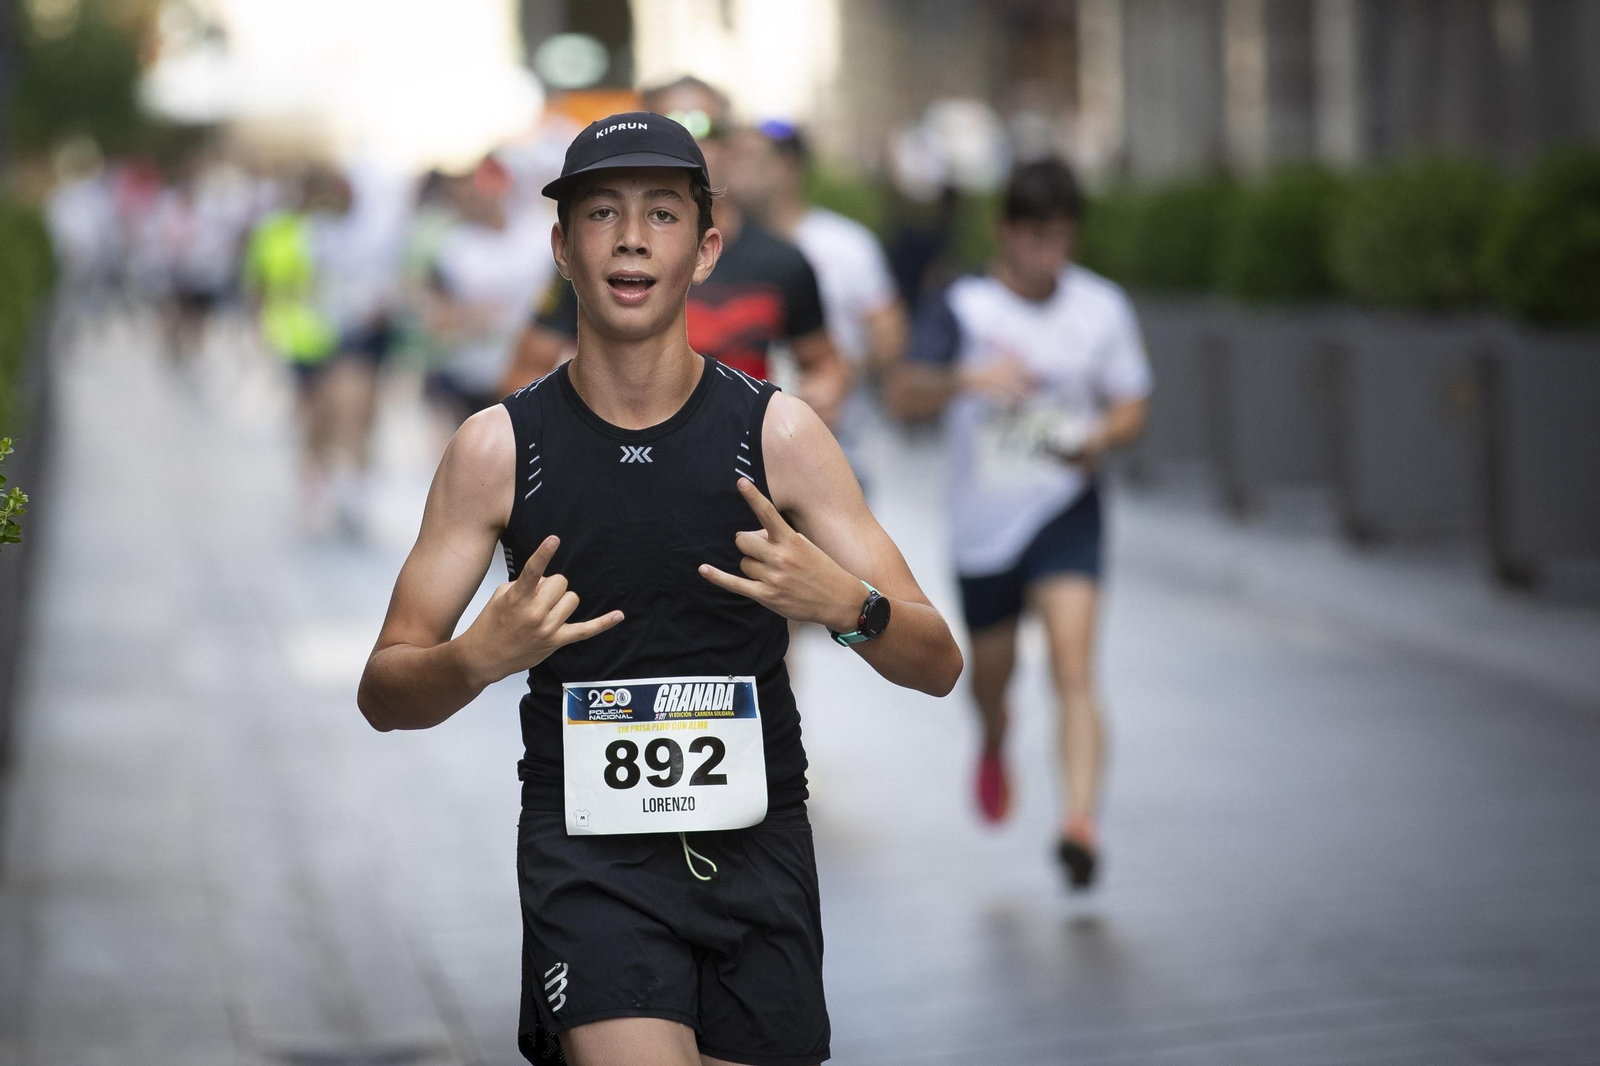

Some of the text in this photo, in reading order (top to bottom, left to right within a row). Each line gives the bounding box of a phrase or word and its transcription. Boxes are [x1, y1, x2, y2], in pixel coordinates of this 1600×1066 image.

[596, 122, 648, 139] KIPRUN
[588, 688, 632, 708] 200
[653, 683, 735, 713] GRANADA
[617, 721, 708, 734] SIN PRISA PERO CON ALMA
[604, 736, 728, 789] 892
[642, 796, 696, 813] LORENZO
